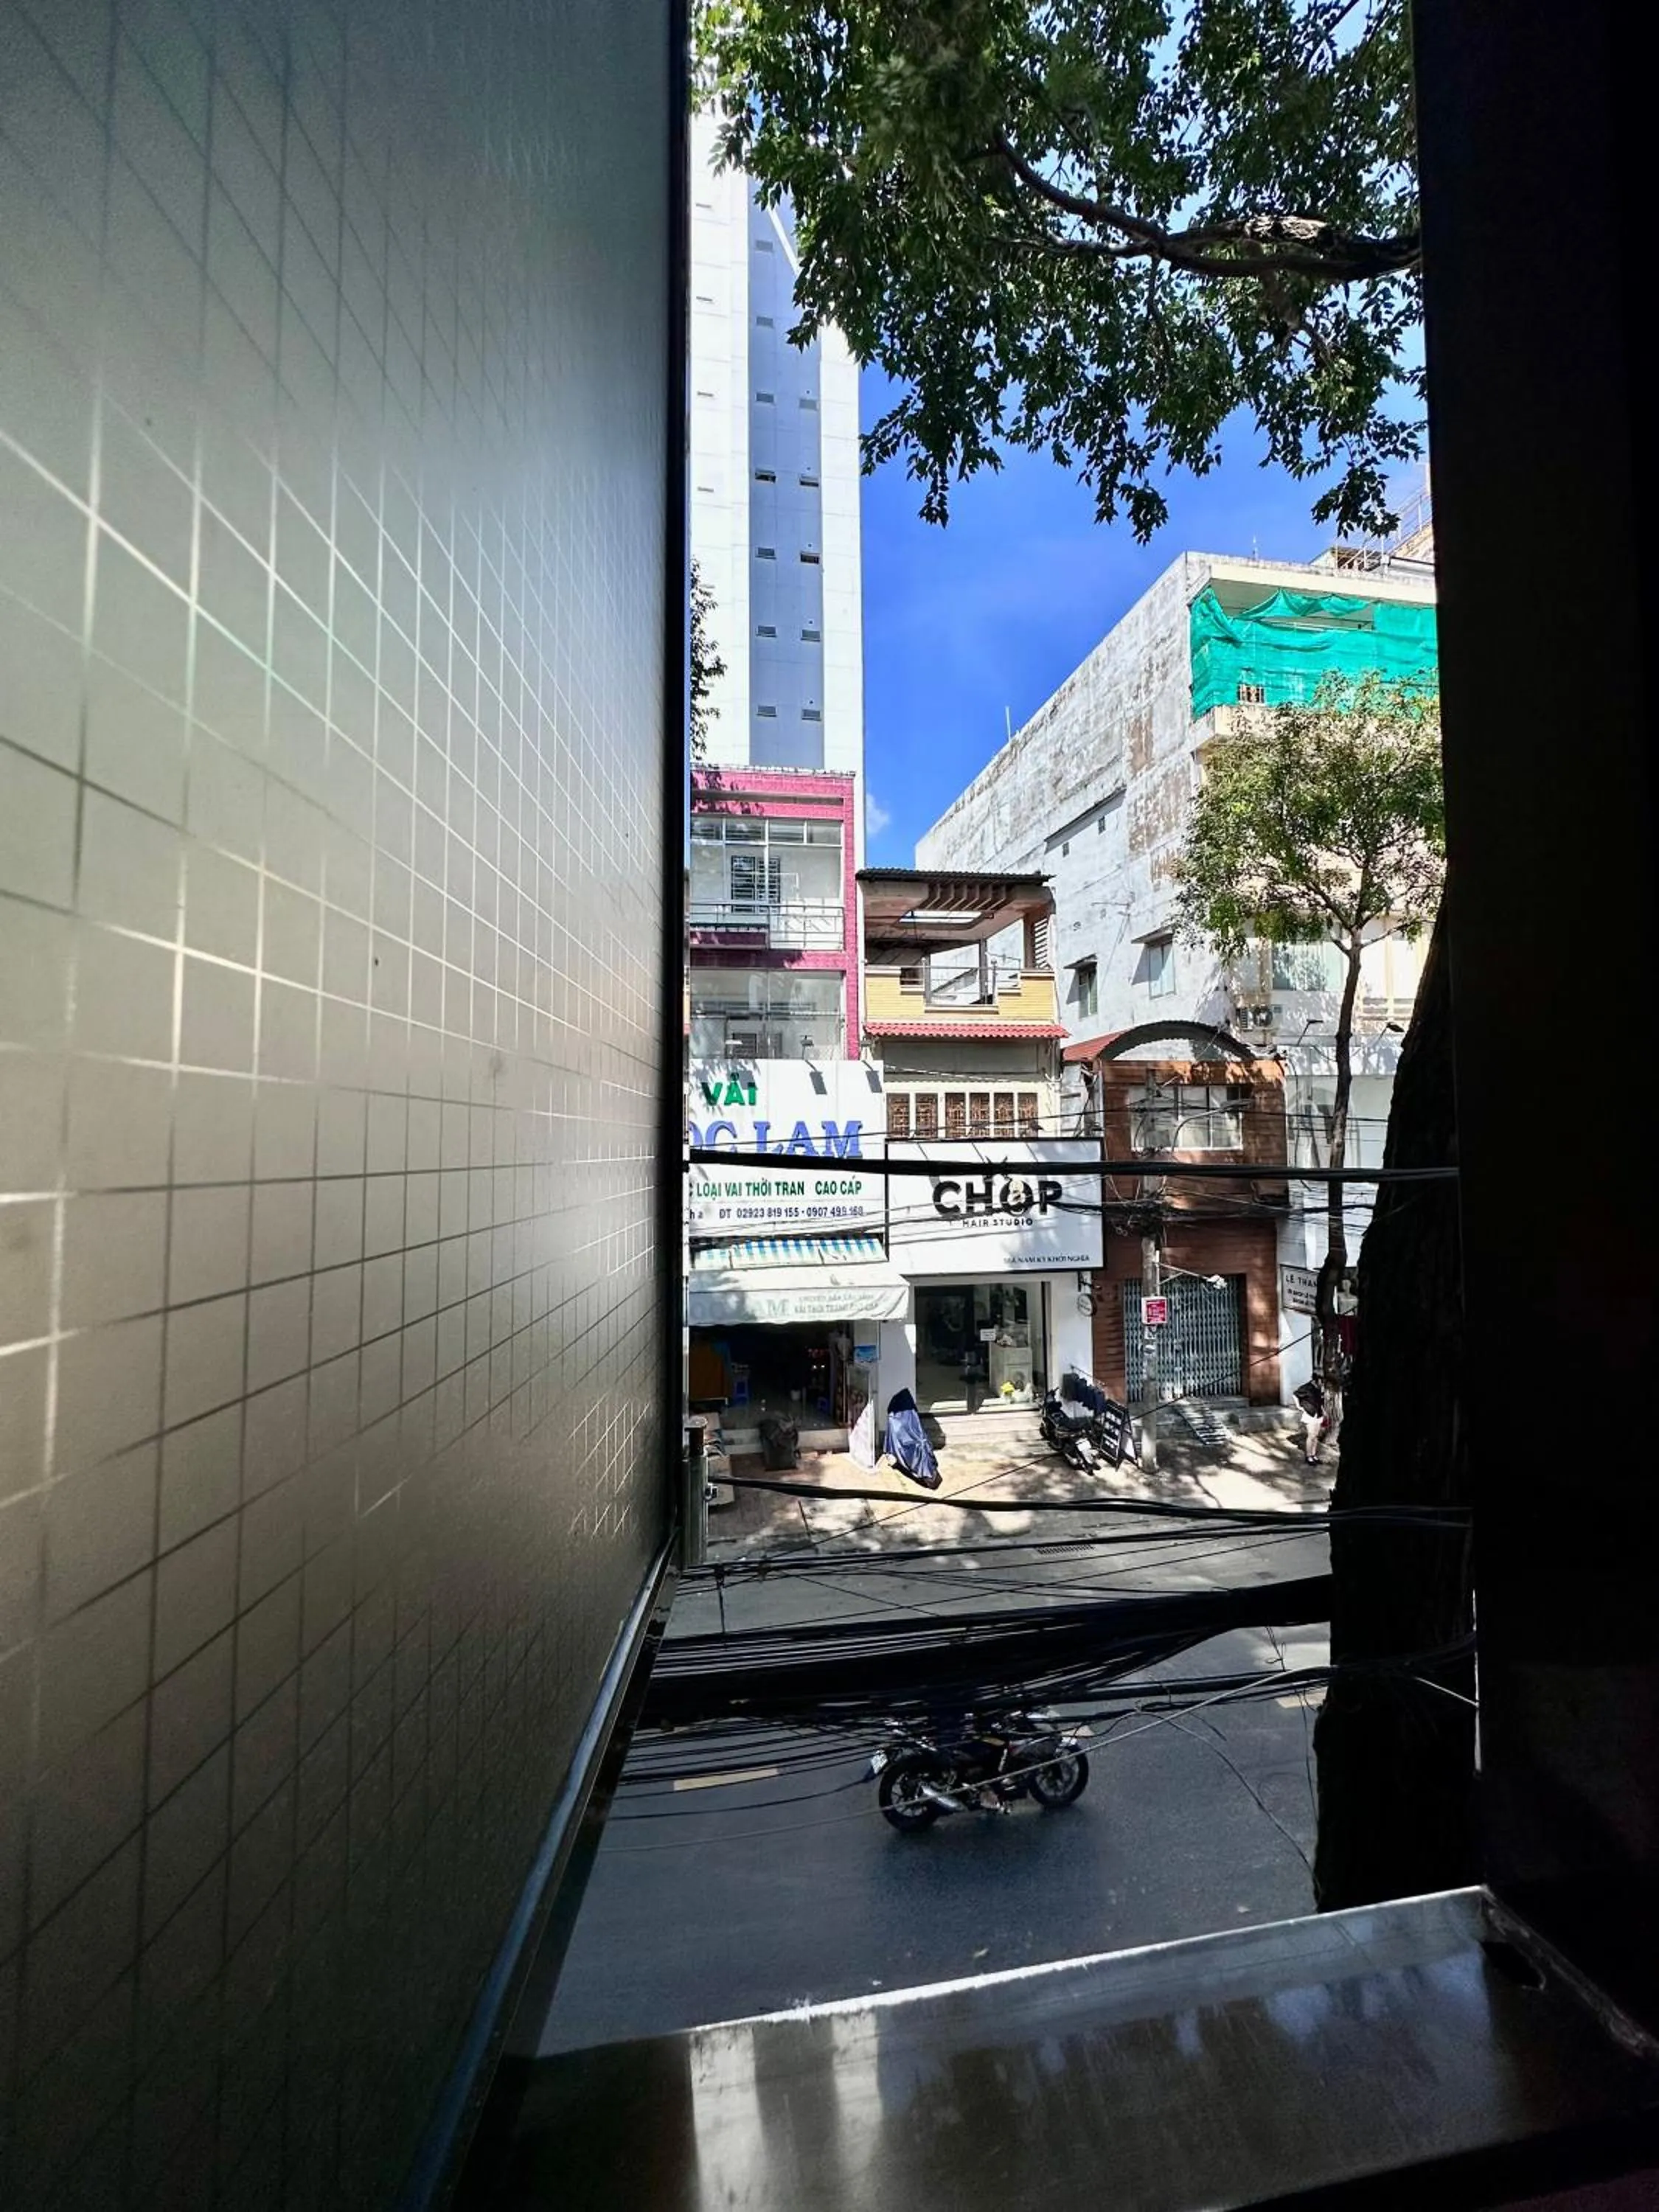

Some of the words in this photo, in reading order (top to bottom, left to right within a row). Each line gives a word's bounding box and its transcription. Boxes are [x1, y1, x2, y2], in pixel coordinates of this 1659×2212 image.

[753, 1121, 863, 1158] LAM
[697, 1182, 722, 1200] LOẠI
[815, 1180, 838, 1195] CAO
[963, 1219, 989, 1227] HAIR
[993, 1217, 1033, 1226] STUDIO
